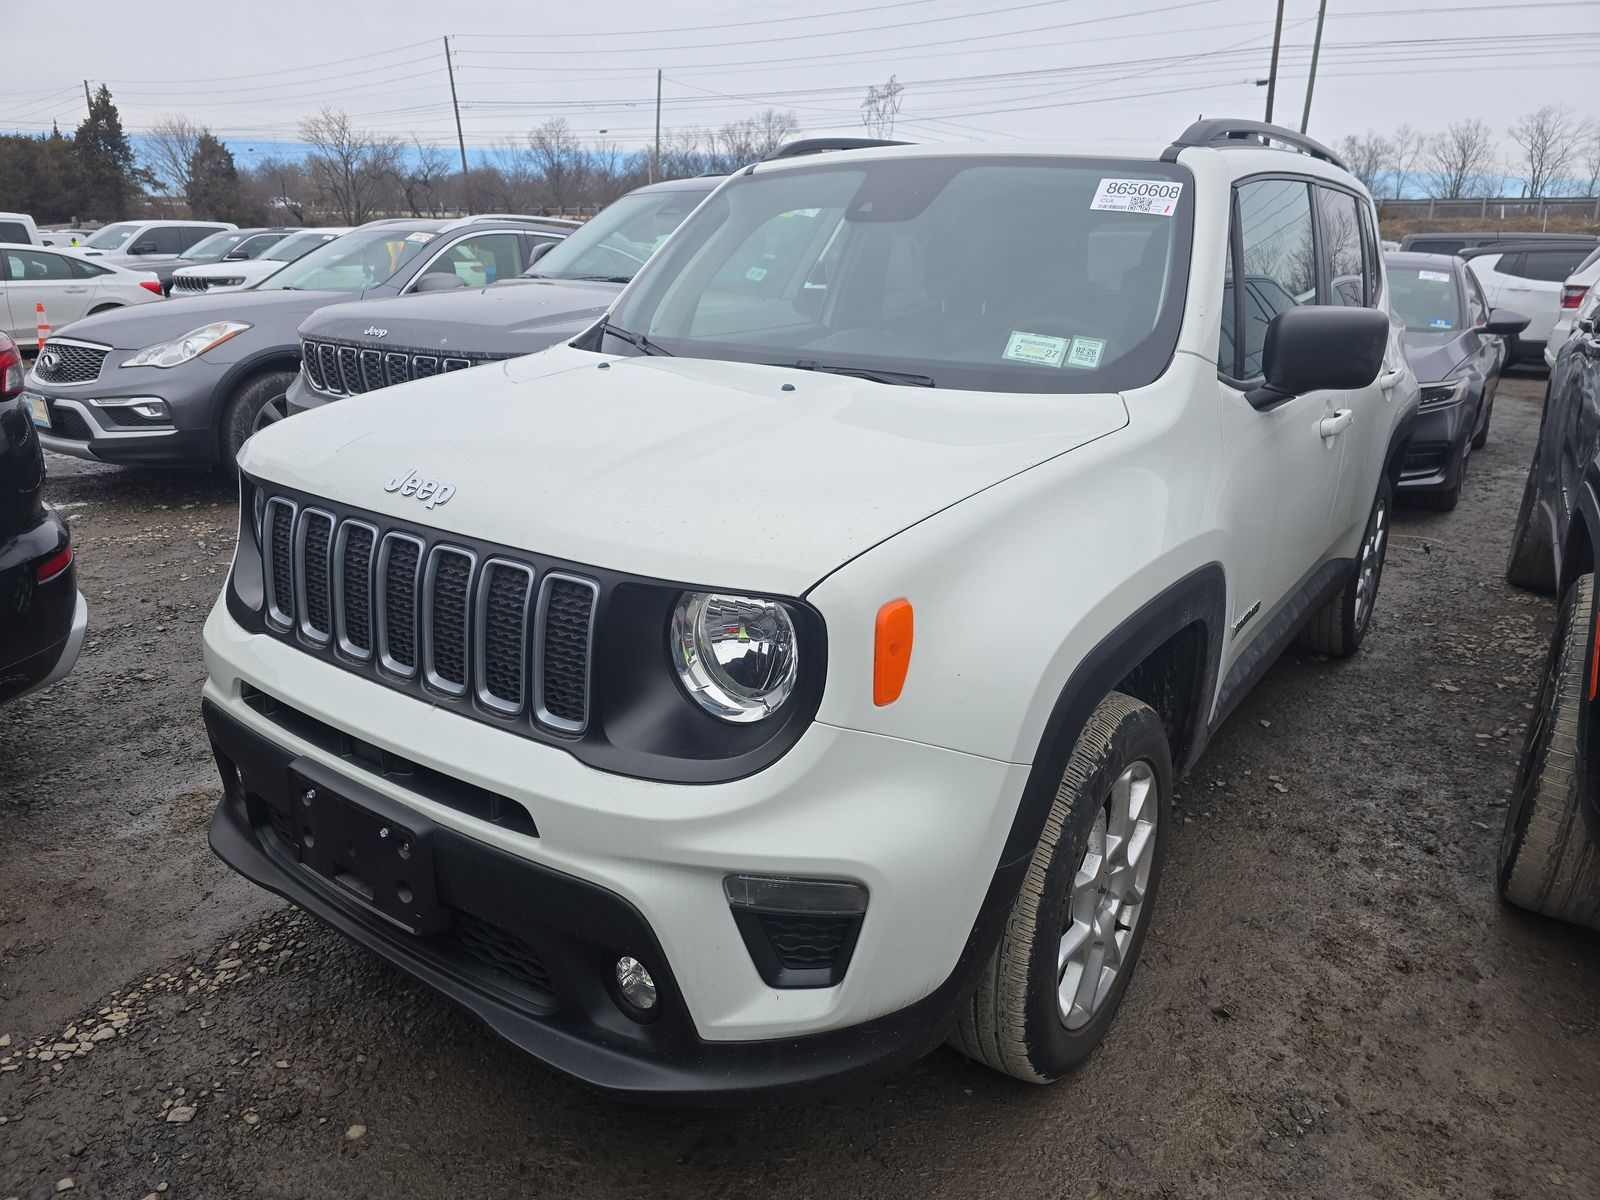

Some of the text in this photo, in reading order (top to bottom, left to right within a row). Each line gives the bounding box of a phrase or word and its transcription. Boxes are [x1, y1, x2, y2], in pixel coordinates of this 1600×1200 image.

[1107, 182, 1180, 199] 8650608
[364, 326, 388, 338] Jeep
[1045, 350, 1059, 358] 27
[383, 468, 456, 510] Jeep
